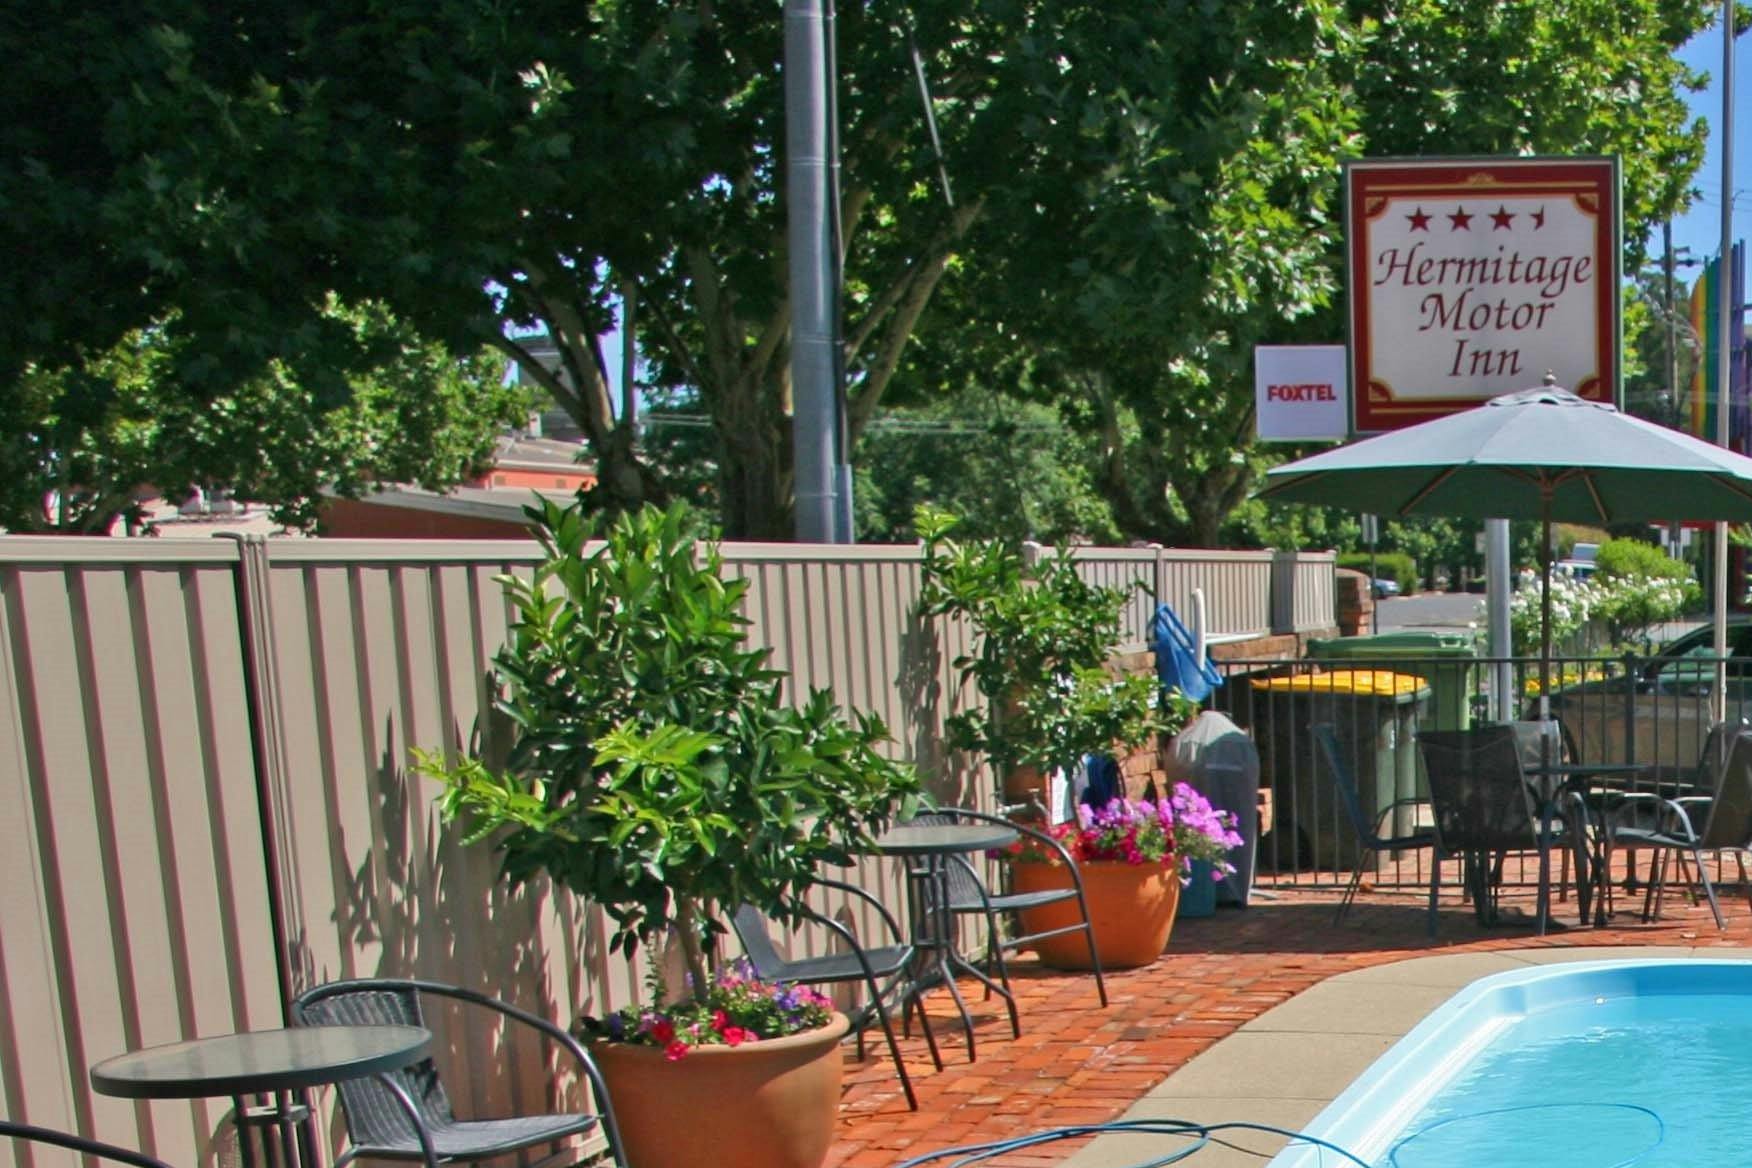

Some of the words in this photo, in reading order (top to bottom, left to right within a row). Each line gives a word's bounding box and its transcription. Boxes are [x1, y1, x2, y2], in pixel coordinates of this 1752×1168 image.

[1374, 241, 1592, 299] Hermitage
[1418, 288, 1555, 332] Motor
[1448, 338, 1523, 377] Inn
[1267, 384, 1337, 402] FOXTEL
